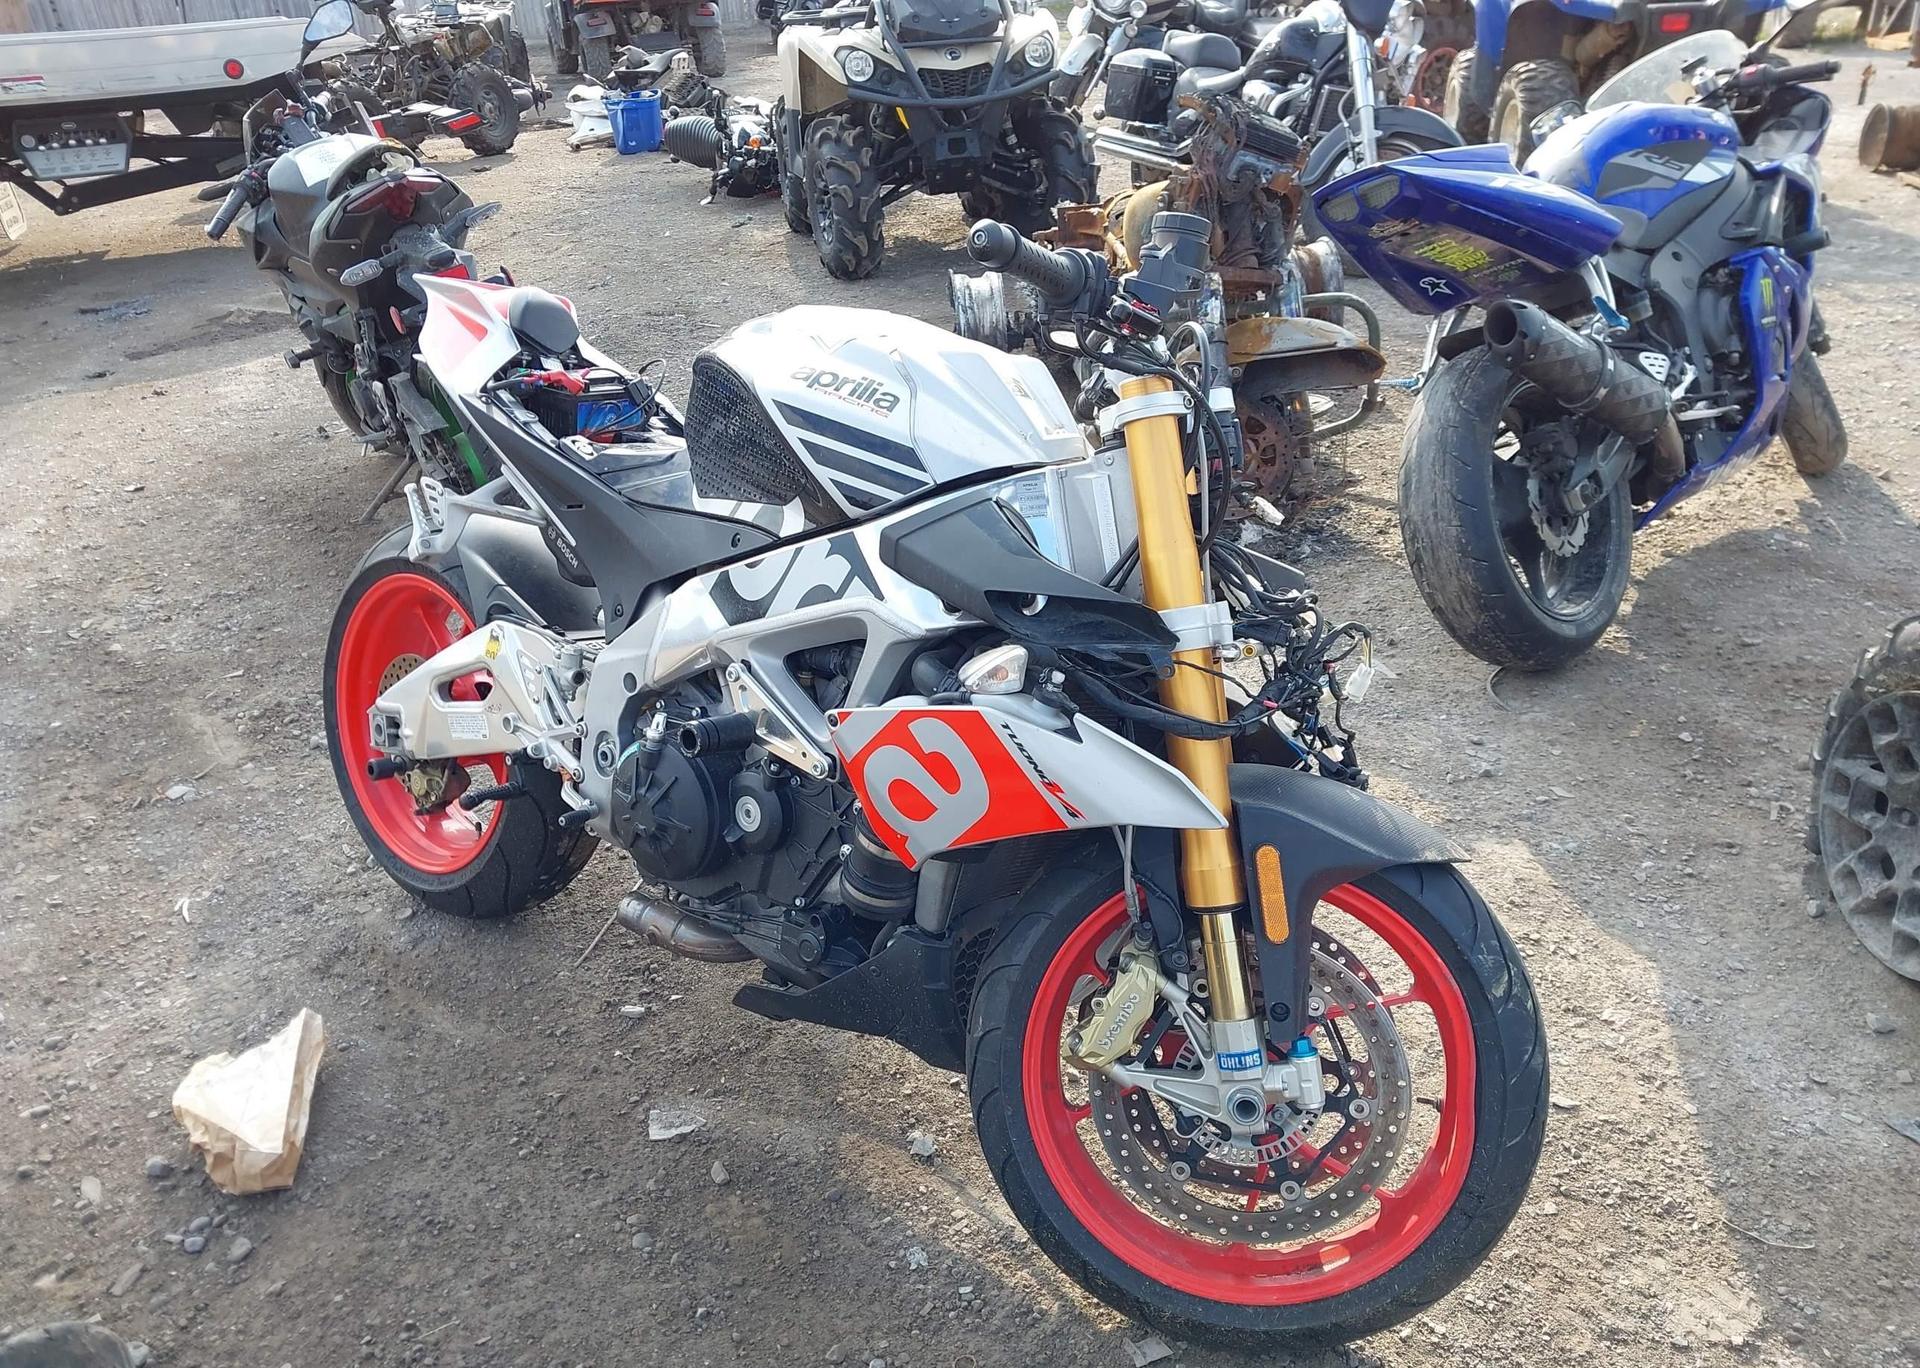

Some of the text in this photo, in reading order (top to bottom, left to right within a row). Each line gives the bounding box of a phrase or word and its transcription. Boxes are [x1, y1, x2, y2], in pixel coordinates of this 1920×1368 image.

[790, 365, 901, 414] aprilia
[556, 537, 579, 568] BOSCH
[1000, 720, 1054, 788] TUONO
[1096, 992, 1141, 1050] brembo
[1220, 1053, 1261, 1069] ÖHLINS
